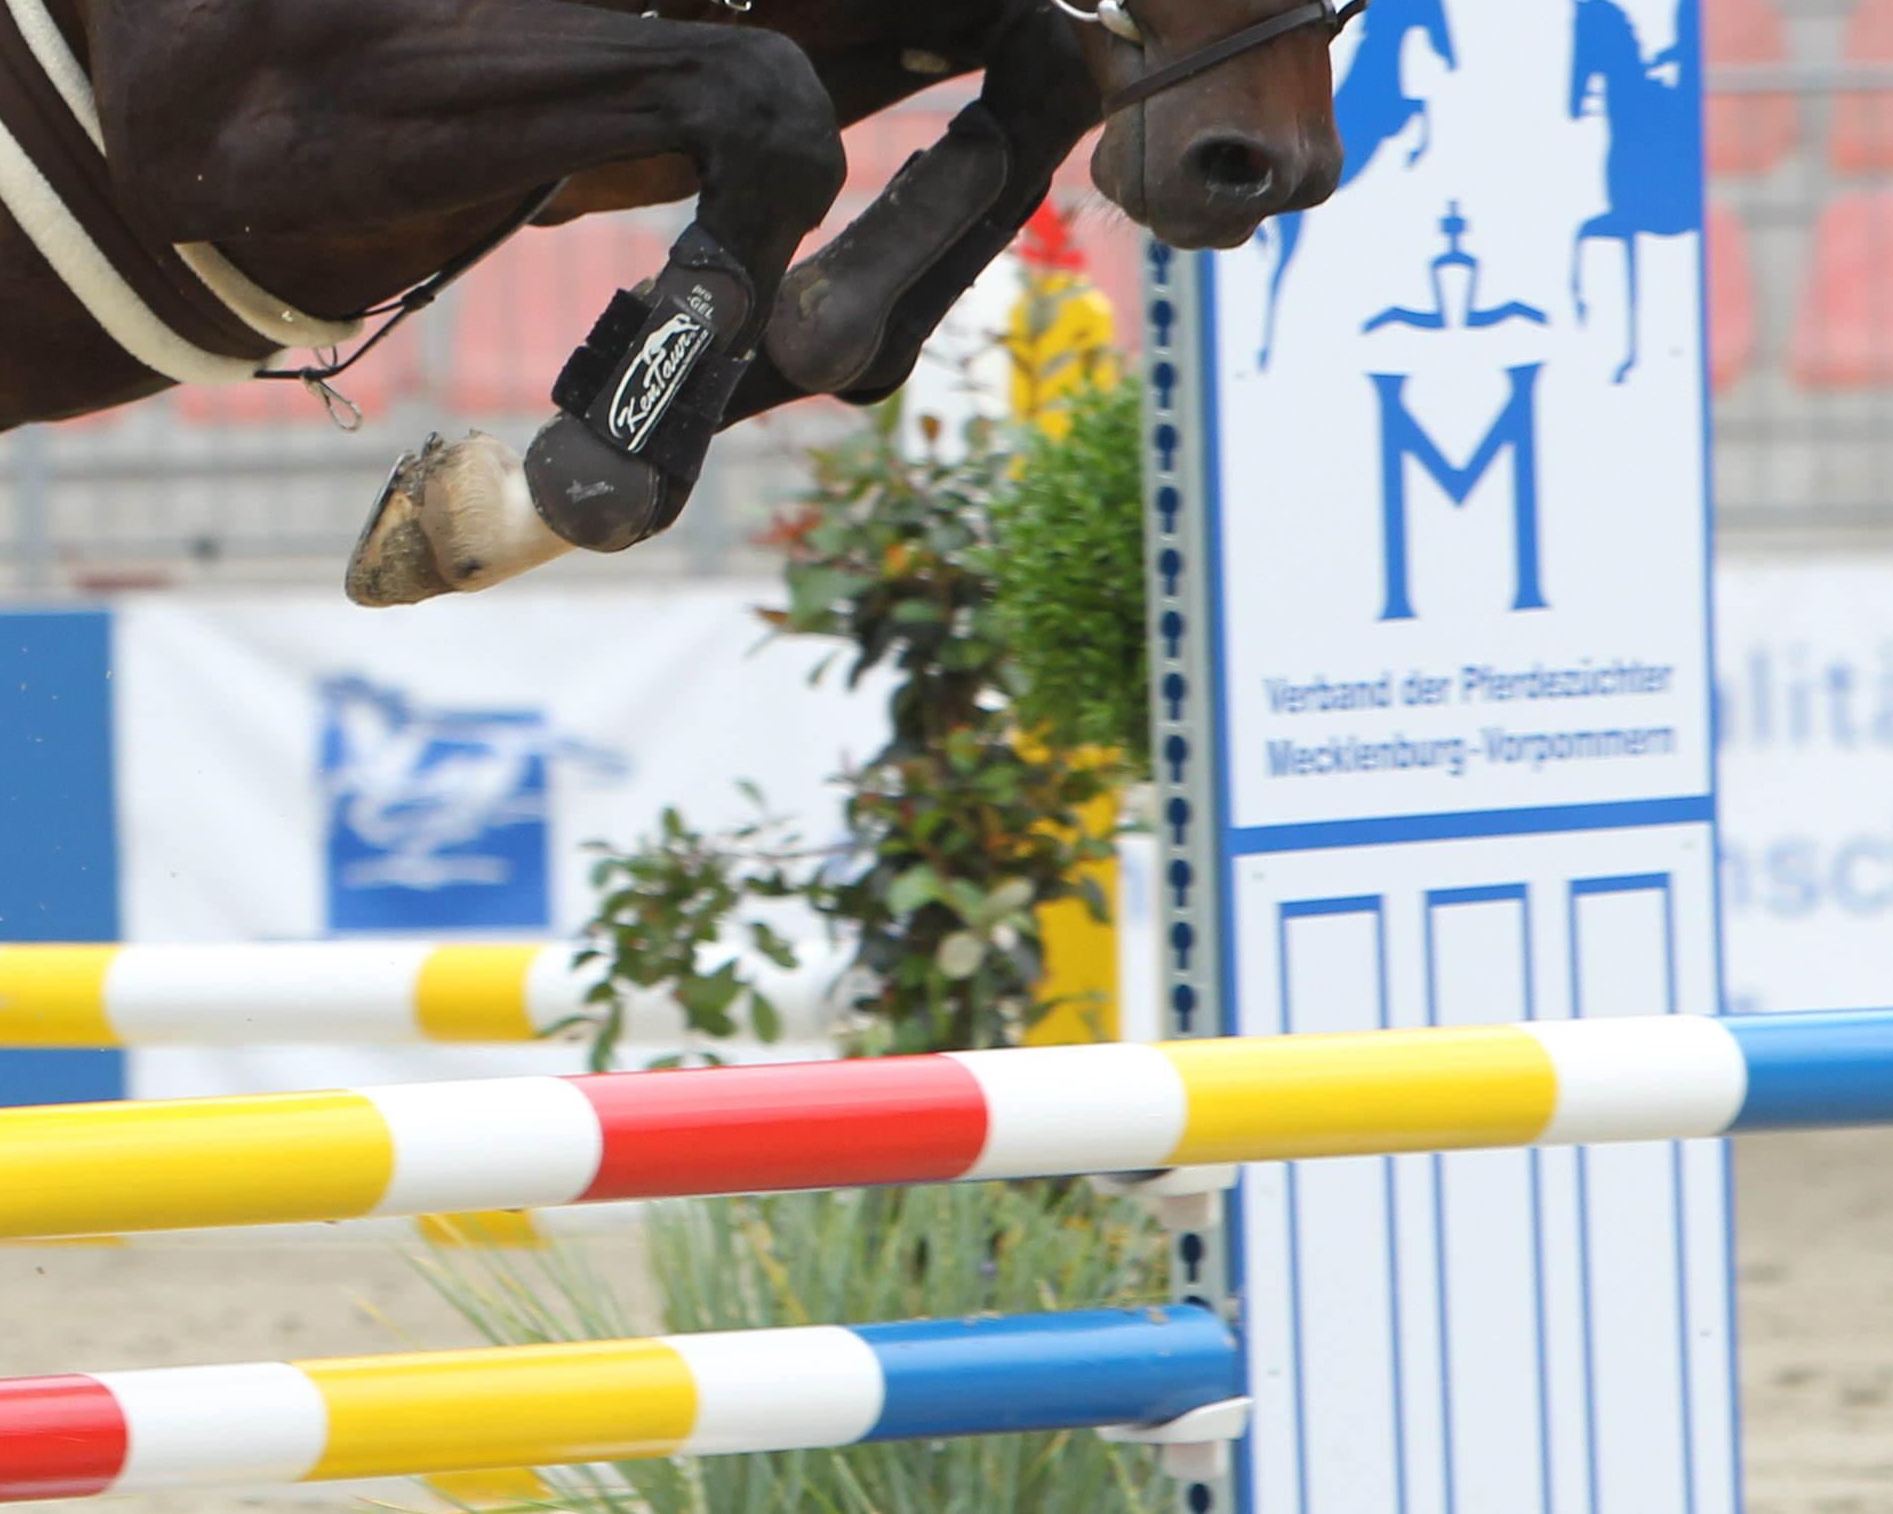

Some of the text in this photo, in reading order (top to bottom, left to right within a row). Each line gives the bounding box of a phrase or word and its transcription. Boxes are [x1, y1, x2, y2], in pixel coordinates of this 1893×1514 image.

[691, 284, 713, 302] pro
[1366, 359, 1552, 623] M
[1261, 657, 1675, 716] Verband der Pferdezüchter
[1264, 729, 1678, 778] Mecklenburg-Vorpommern
